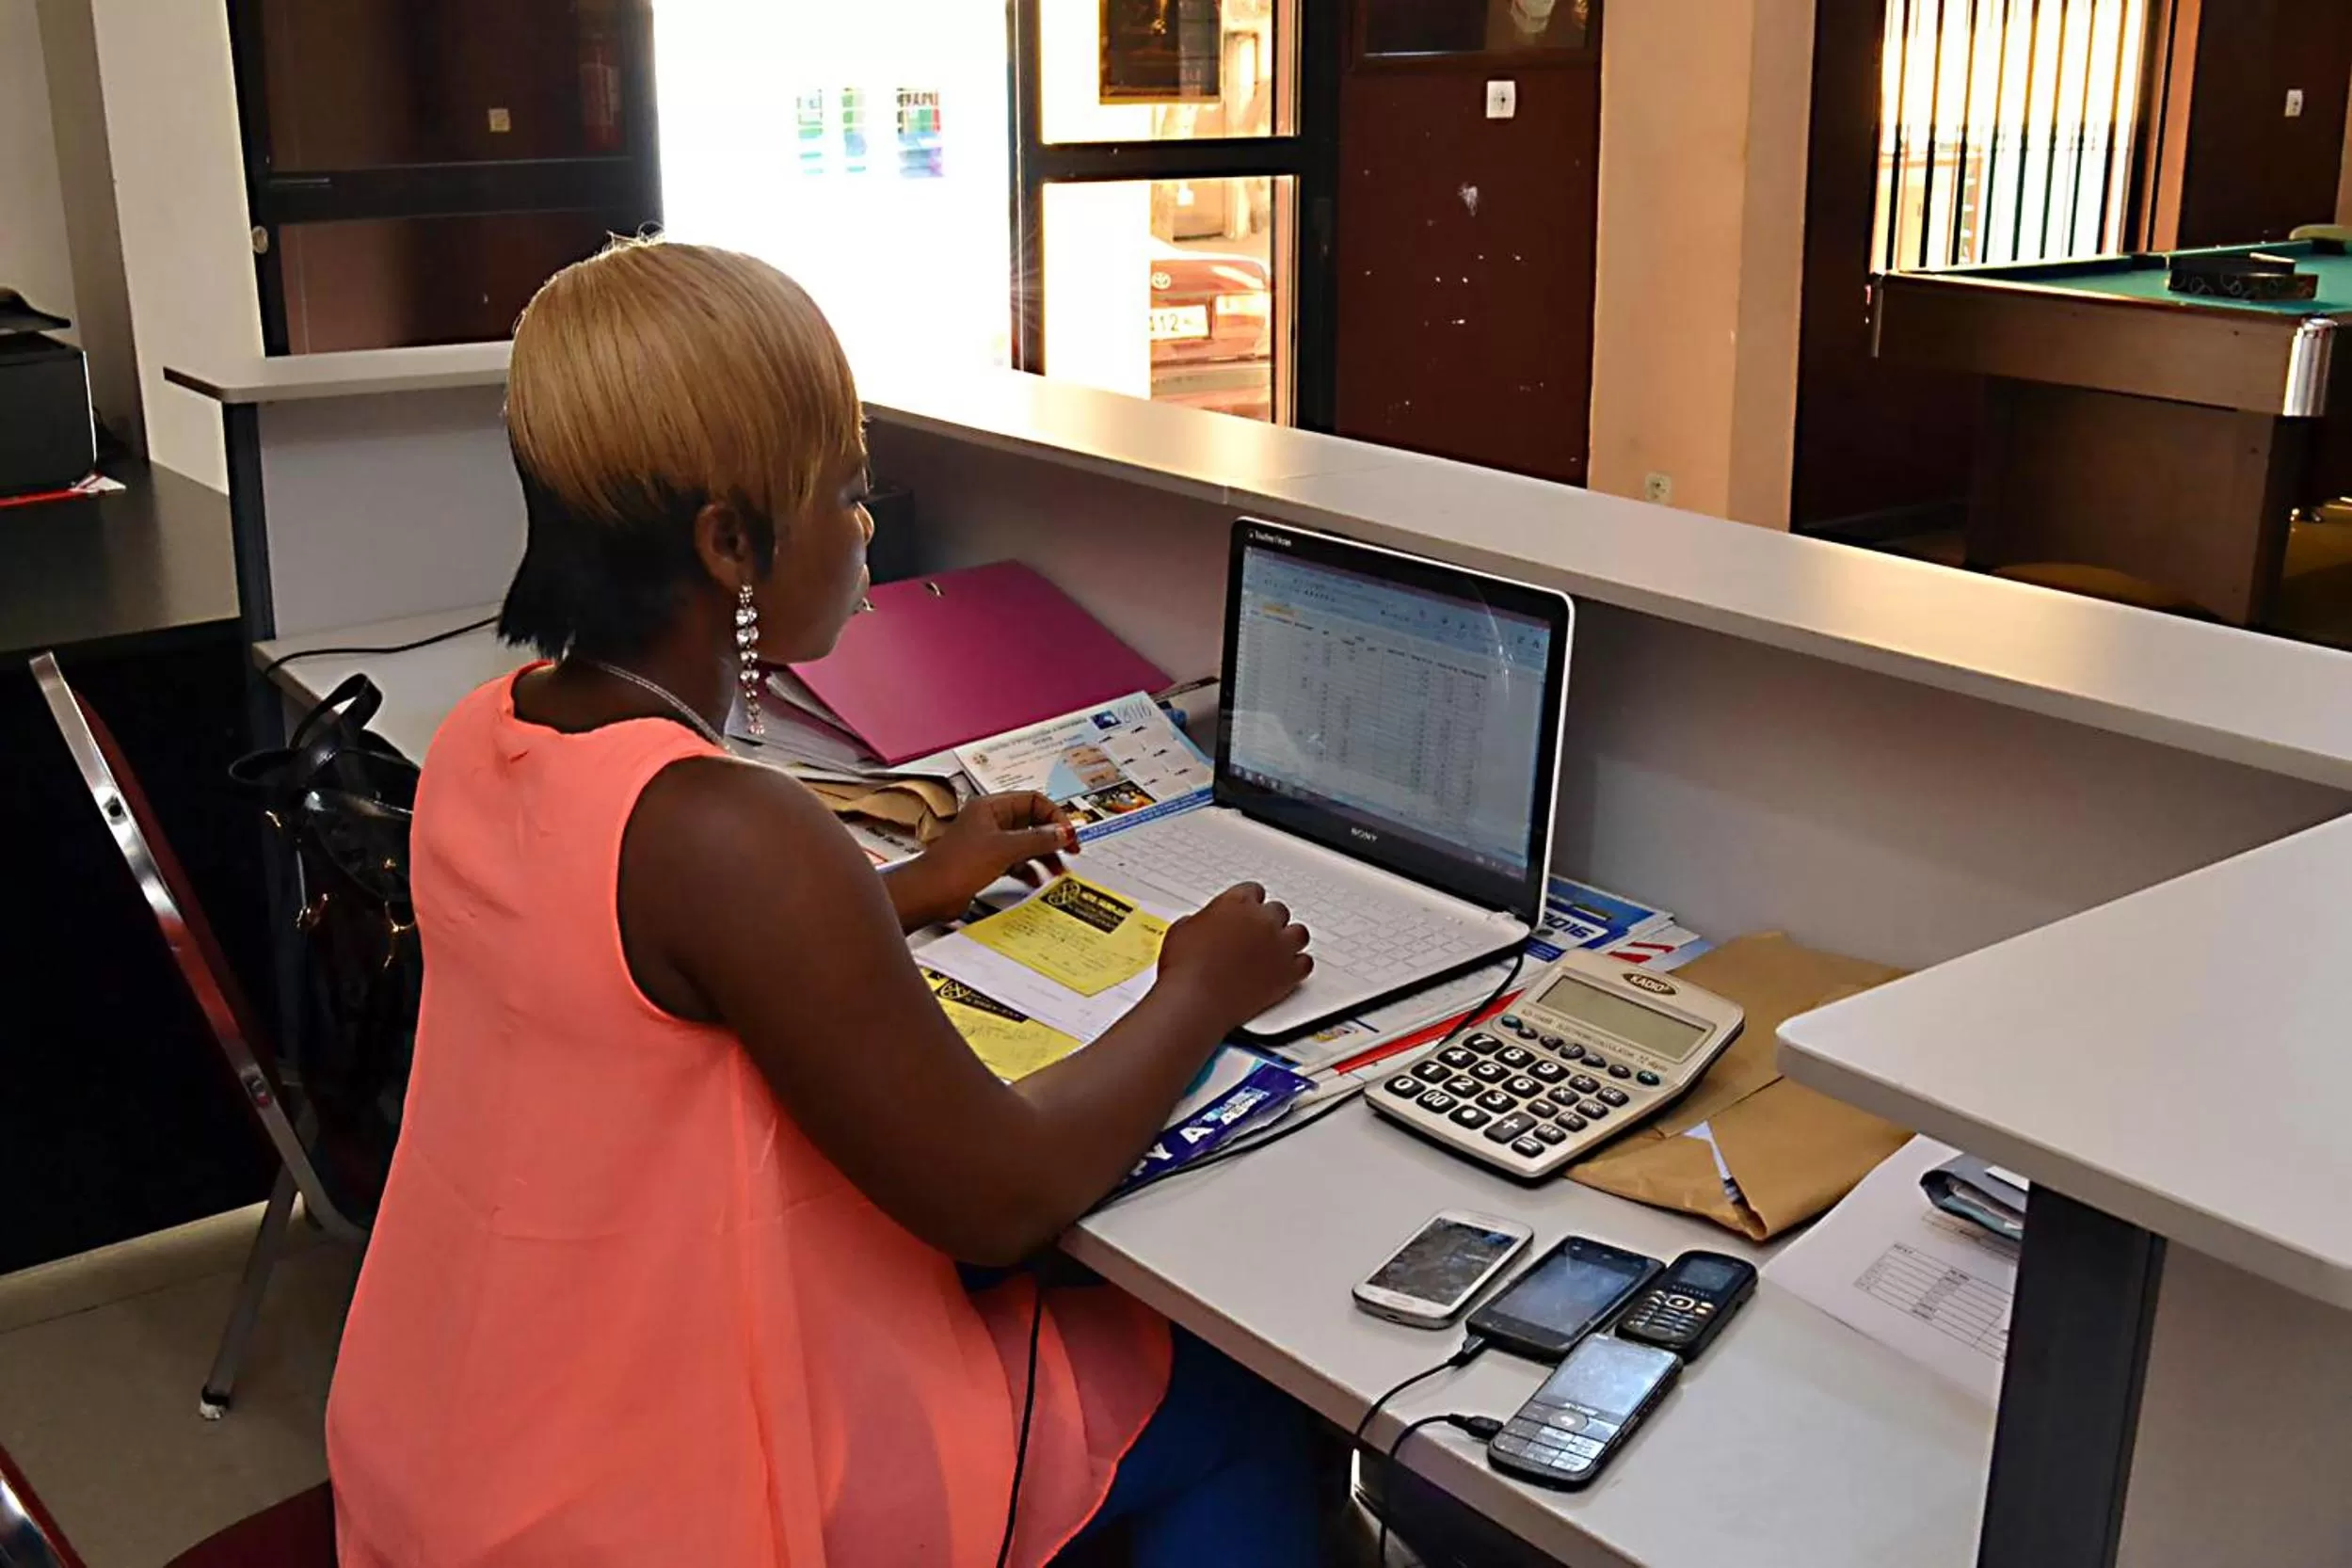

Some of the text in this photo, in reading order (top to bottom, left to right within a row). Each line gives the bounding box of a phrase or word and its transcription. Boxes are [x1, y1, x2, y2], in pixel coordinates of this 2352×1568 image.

[1630, 975, 1667, 992] KADIO
[1478, 1034, 1496, 1046] 7
[1447, 1050, 1466, 1061] 4
[1504, 1048, 1525, 1061] 8
[1423, 1064, 1440, 1075] 1
[1478, 1064, 1499, 1076] 5
[1536, 1063, 1559, 1075] 9
[1394, 1079, 1414, 1090] 0
[1451, 1078, 1475, 1090] 2
[1513, 1079, 1534, 1090] 6
[1485, 1092, 1507, 1105] 3
